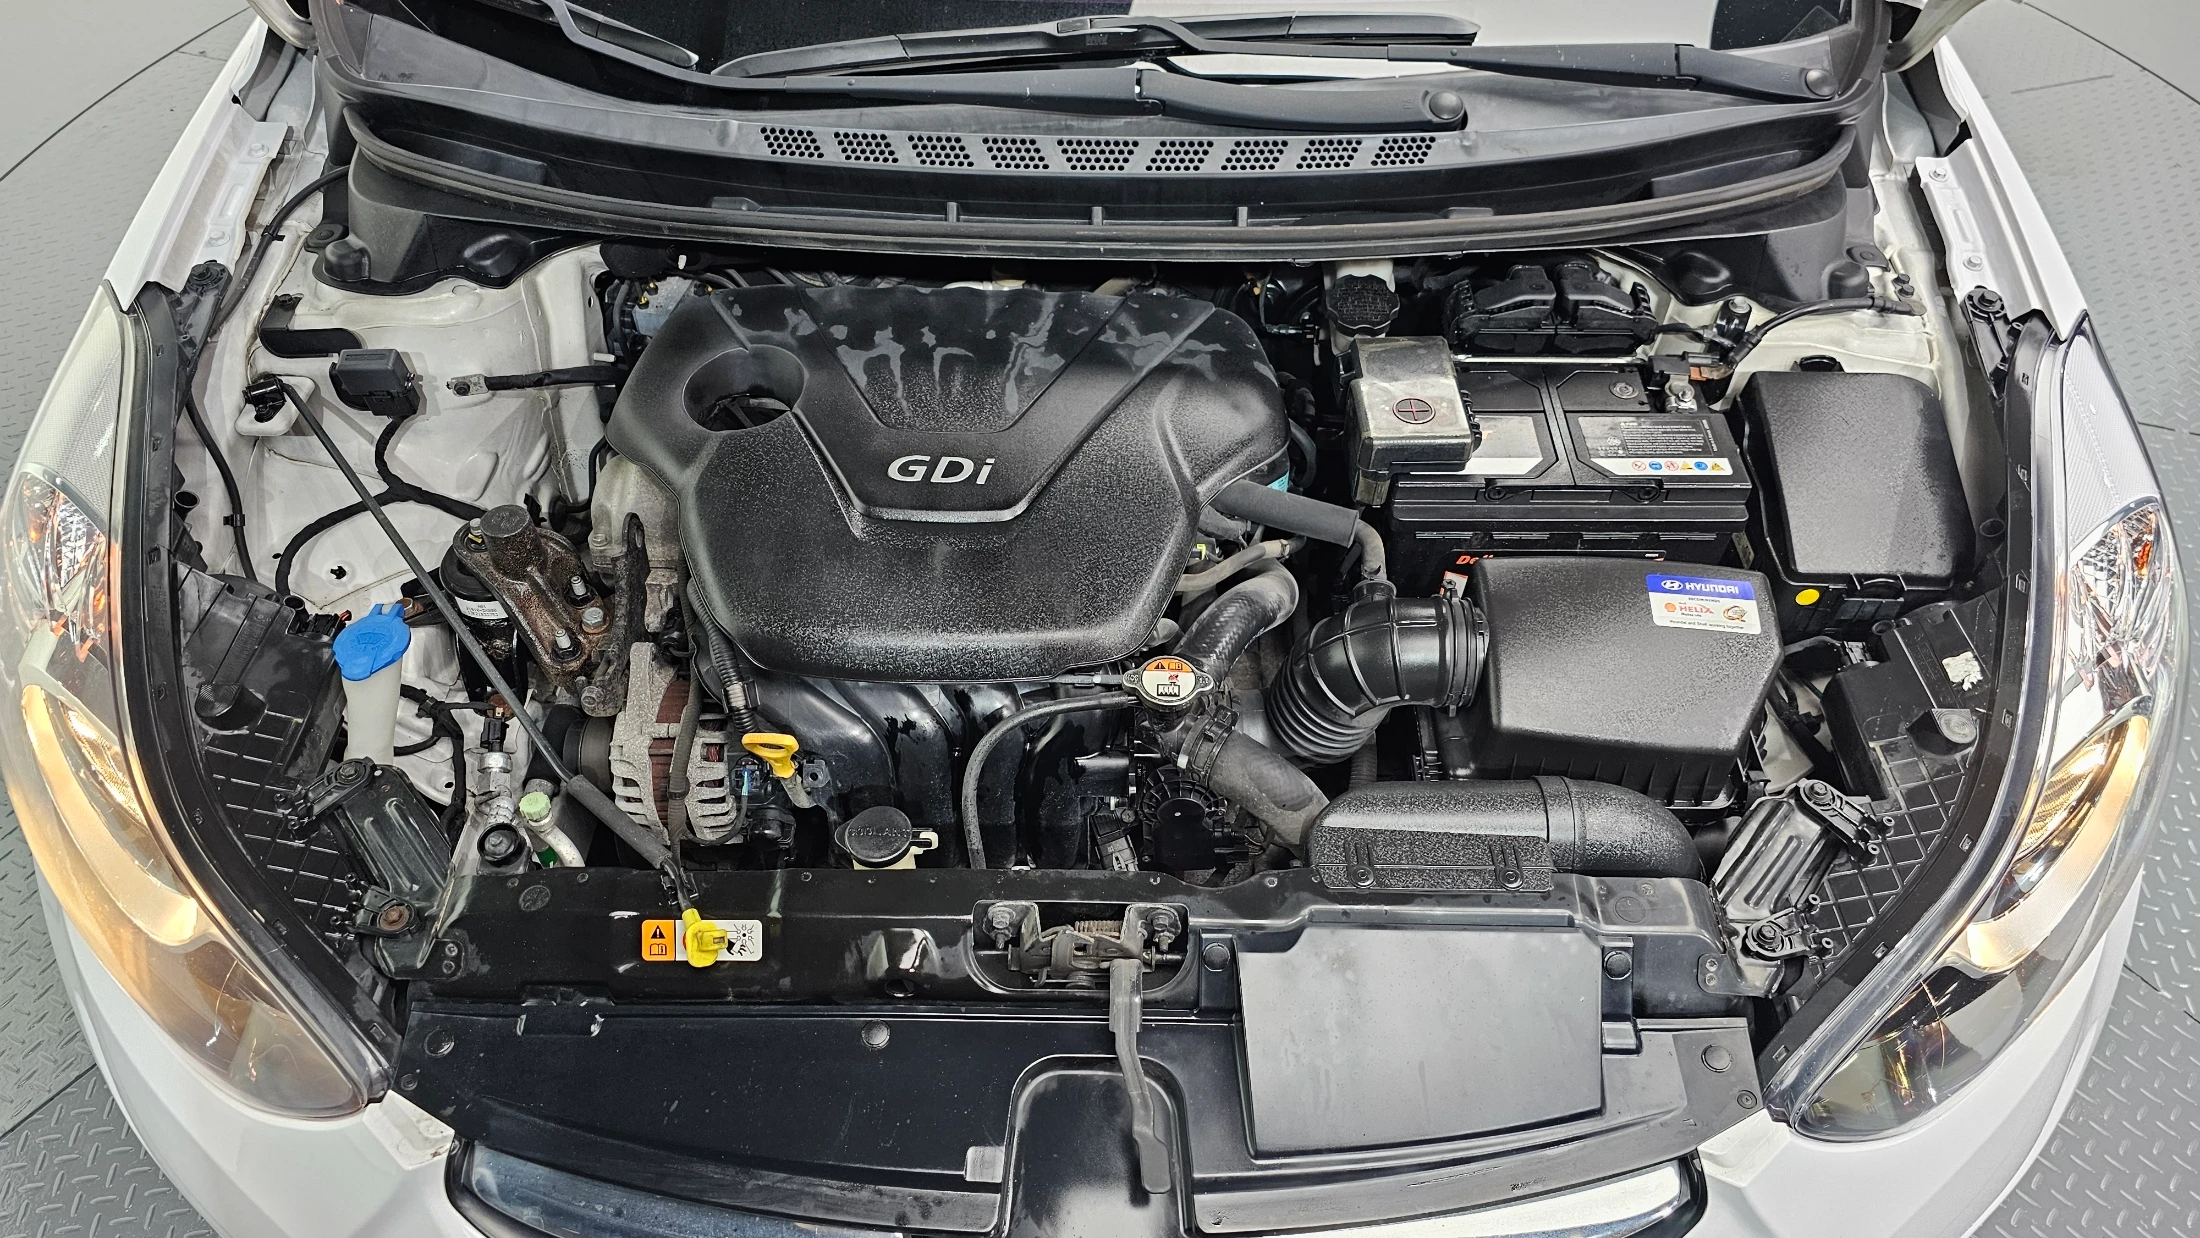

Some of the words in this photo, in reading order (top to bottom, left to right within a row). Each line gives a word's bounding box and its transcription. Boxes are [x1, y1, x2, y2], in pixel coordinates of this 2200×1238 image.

[887, 454, 996, 485] GDi
[1686, 582, 1738, 594] HYUNDAI
[1679, 604, 1714, 614] HELIX
